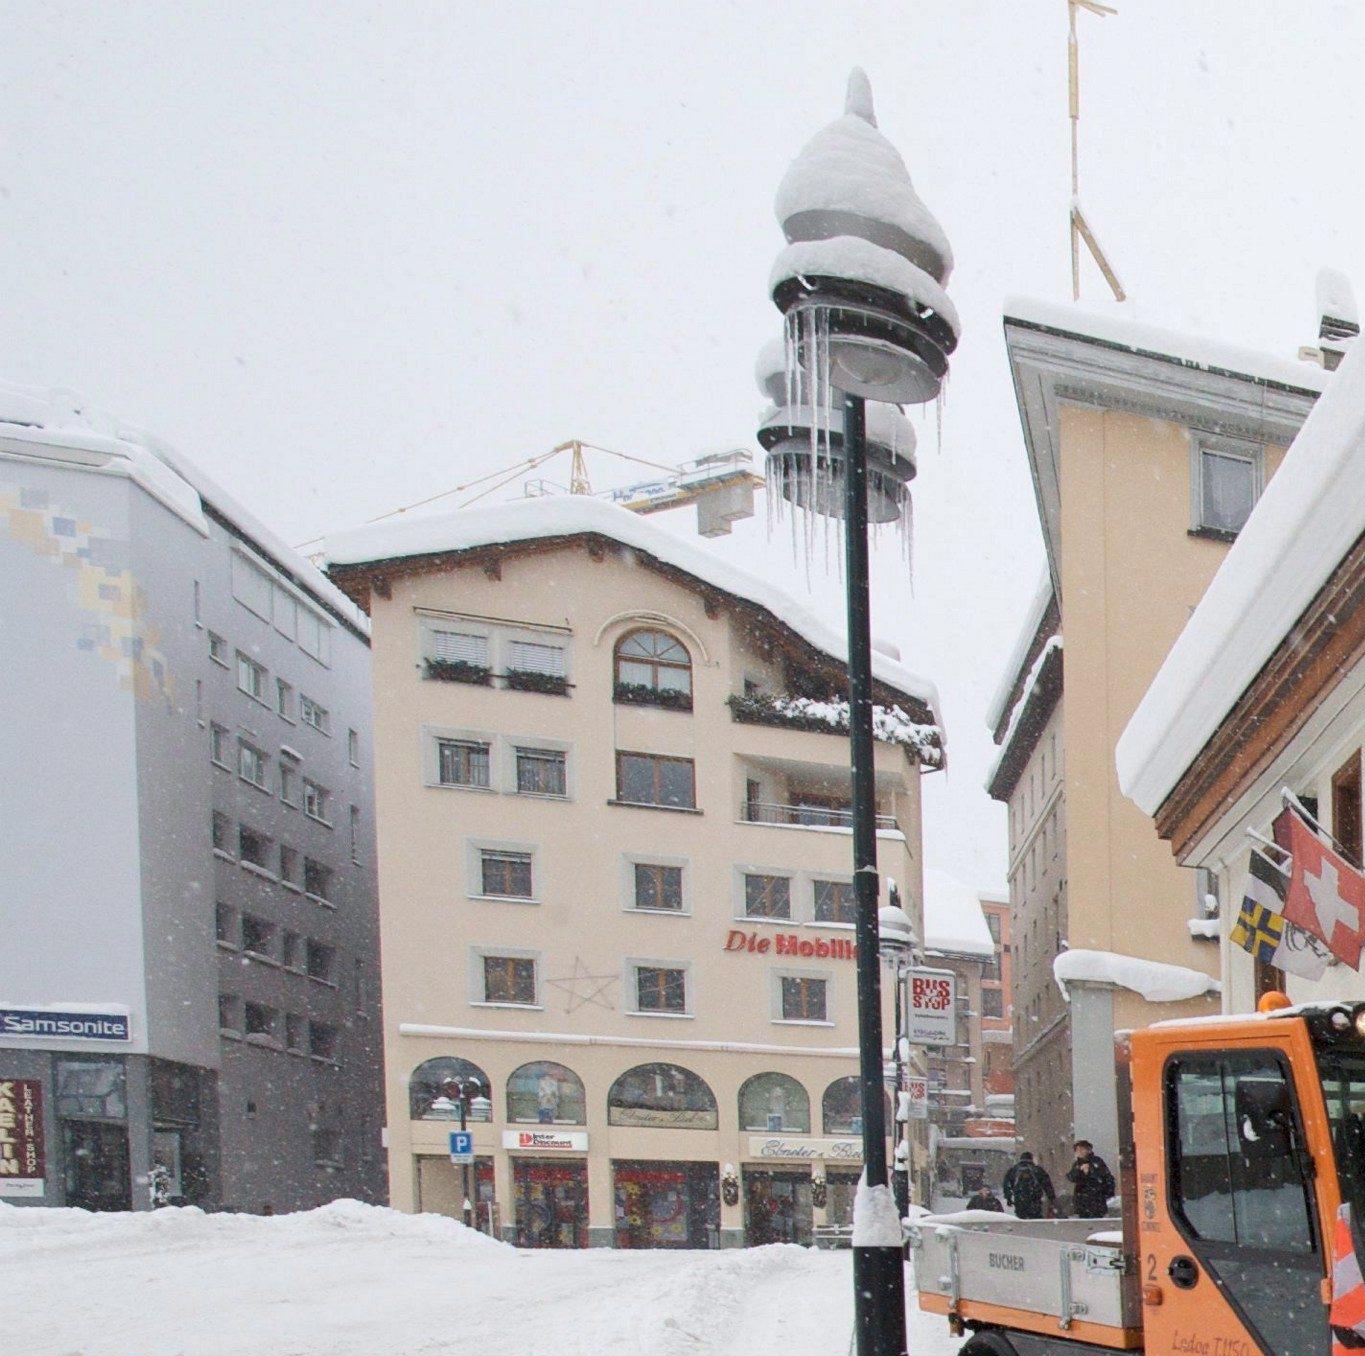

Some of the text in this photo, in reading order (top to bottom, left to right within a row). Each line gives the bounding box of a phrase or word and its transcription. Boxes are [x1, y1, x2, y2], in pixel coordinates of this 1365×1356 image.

[723, 929, 771, 955] Die
[912, 977, 950, 997] BUS
[912, 995, 951, 1010] STOP
[3, 1015, 125, 1036] Samsonite
[1146, 1253, 1157, 1281] 2
